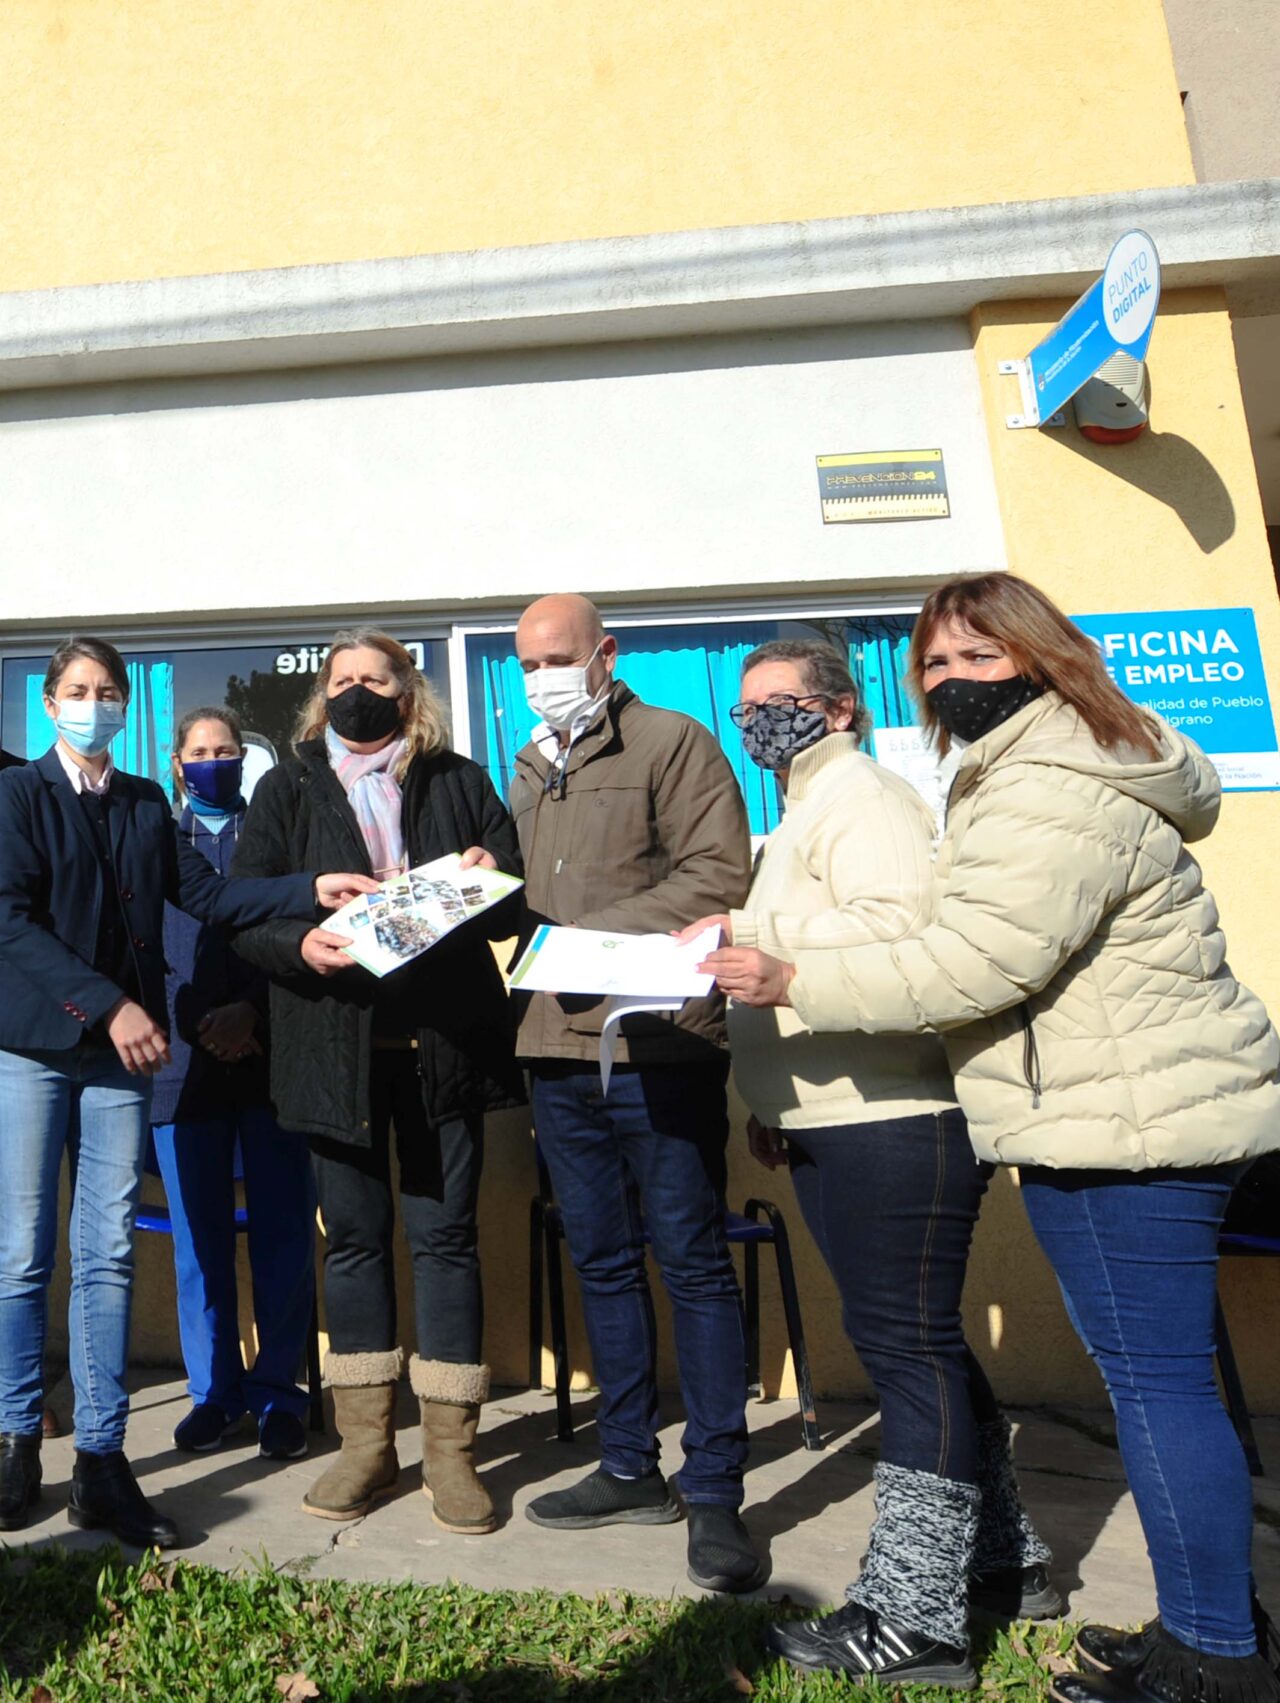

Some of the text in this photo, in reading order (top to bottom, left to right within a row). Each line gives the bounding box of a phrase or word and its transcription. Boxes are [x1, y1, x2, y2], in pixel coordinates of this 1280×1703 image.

[1108, 251, 1148, 304] PUNTO
[1112, 276, 1152, 324] DIGITAL
[1124, 661, 1245, 685] EMPLEO
[1140, 695, 1264, 711] alidad de Pueblo
[1166, 714, 1214, 727] lgrano
